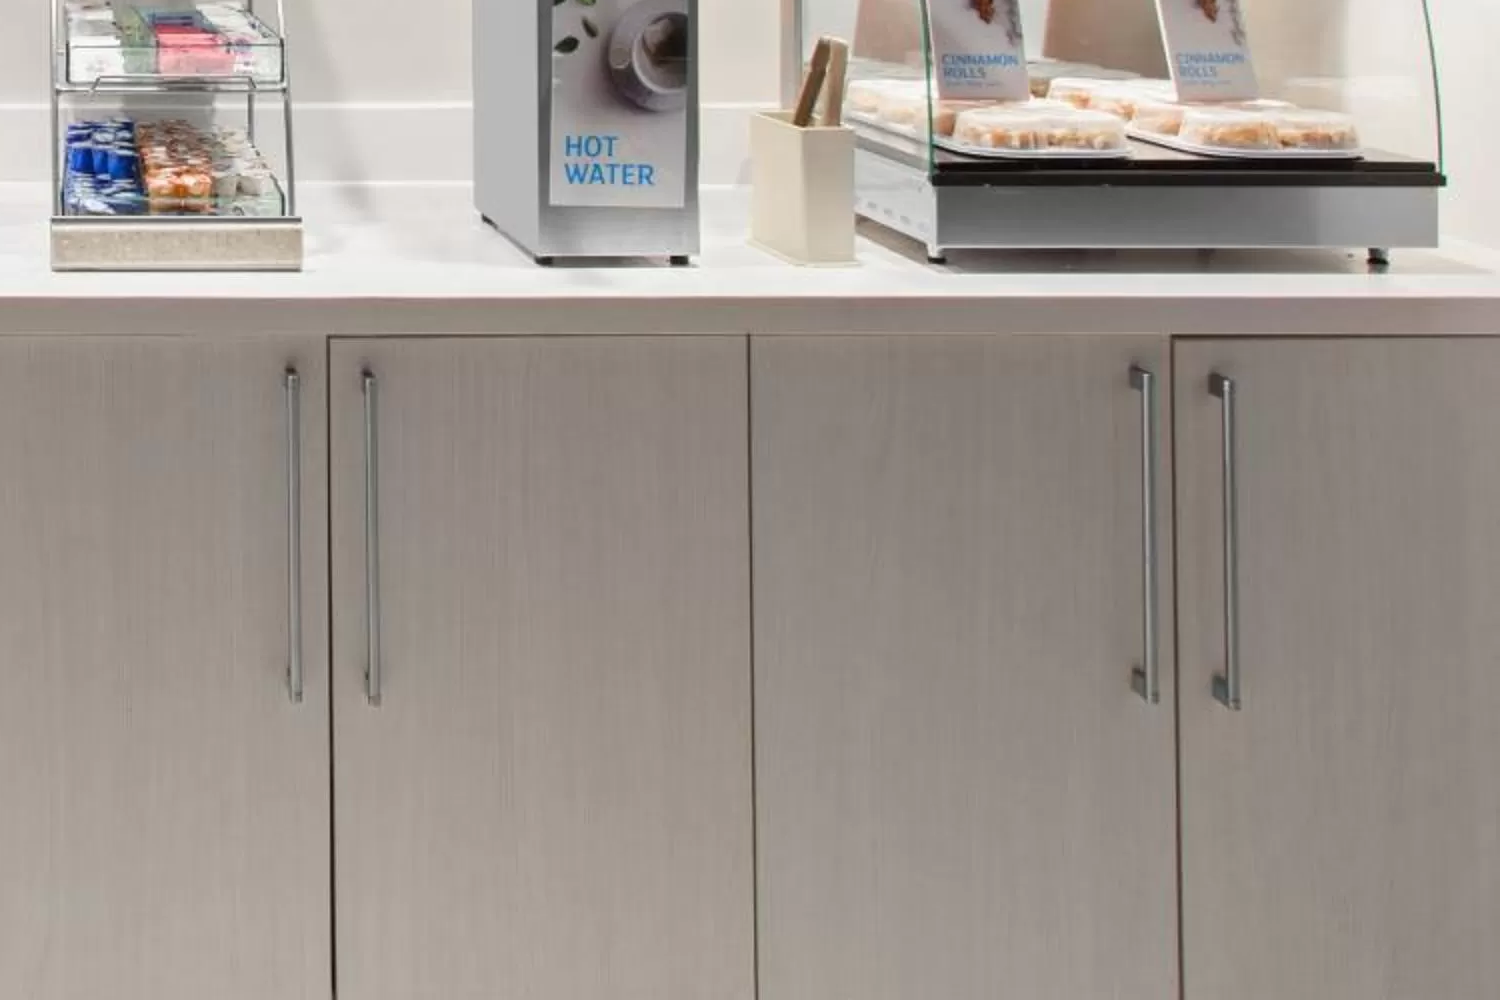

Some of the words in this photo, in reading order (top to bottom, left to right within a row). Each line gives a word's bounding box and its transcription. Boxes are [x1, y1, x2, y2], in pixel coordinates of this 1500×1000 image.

[942, 53, 1019, 66] CINNAMON
[565, 135, 618, 157] HOT
[564, 163, 655, 185] WATER
